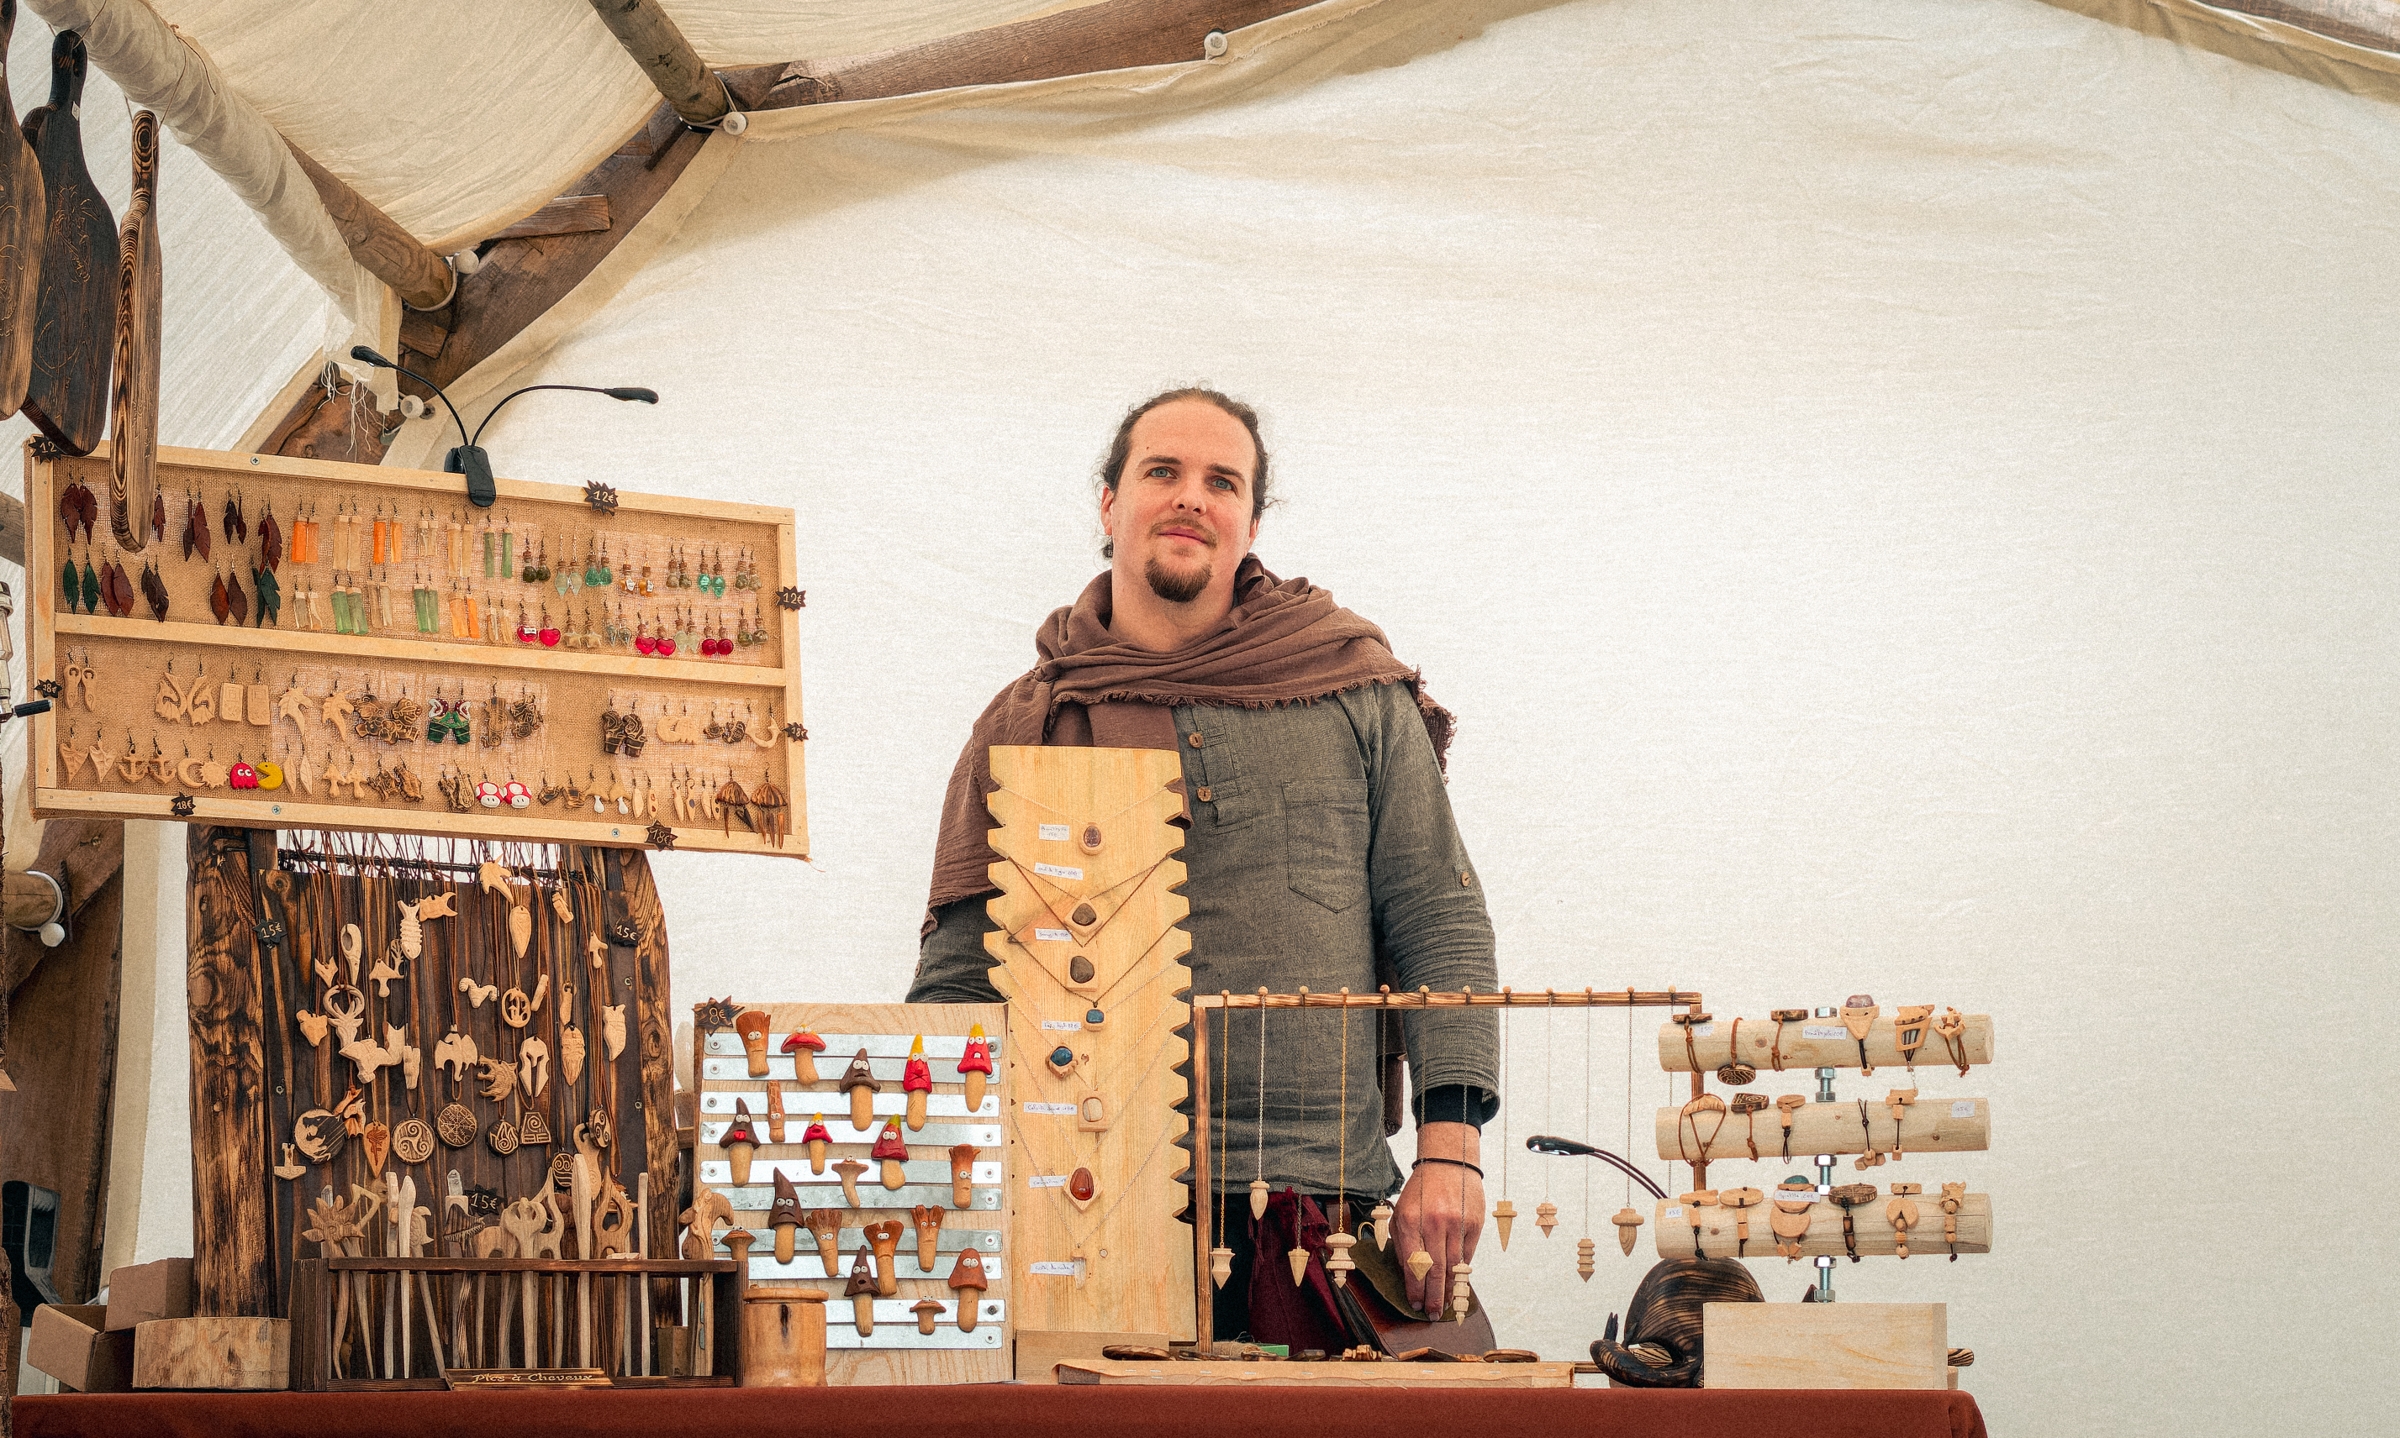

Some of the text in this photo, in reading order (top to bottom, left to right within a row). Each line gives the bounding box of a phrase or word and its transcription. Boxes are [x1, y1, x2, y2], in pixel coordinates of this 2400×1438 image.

[593, 490, 614, 504] 12€
[783, 592, 802, 605] 12€
[176, 799, 193, 810] 18€
[260, 922, 282, 938] 15€
[616, 924, 637, 941] 15€
[470, 1192, 498, 1210] 15€
[511, 1372, 523, 1382] à
[527, 1373, 593, 1382] Cheveux
